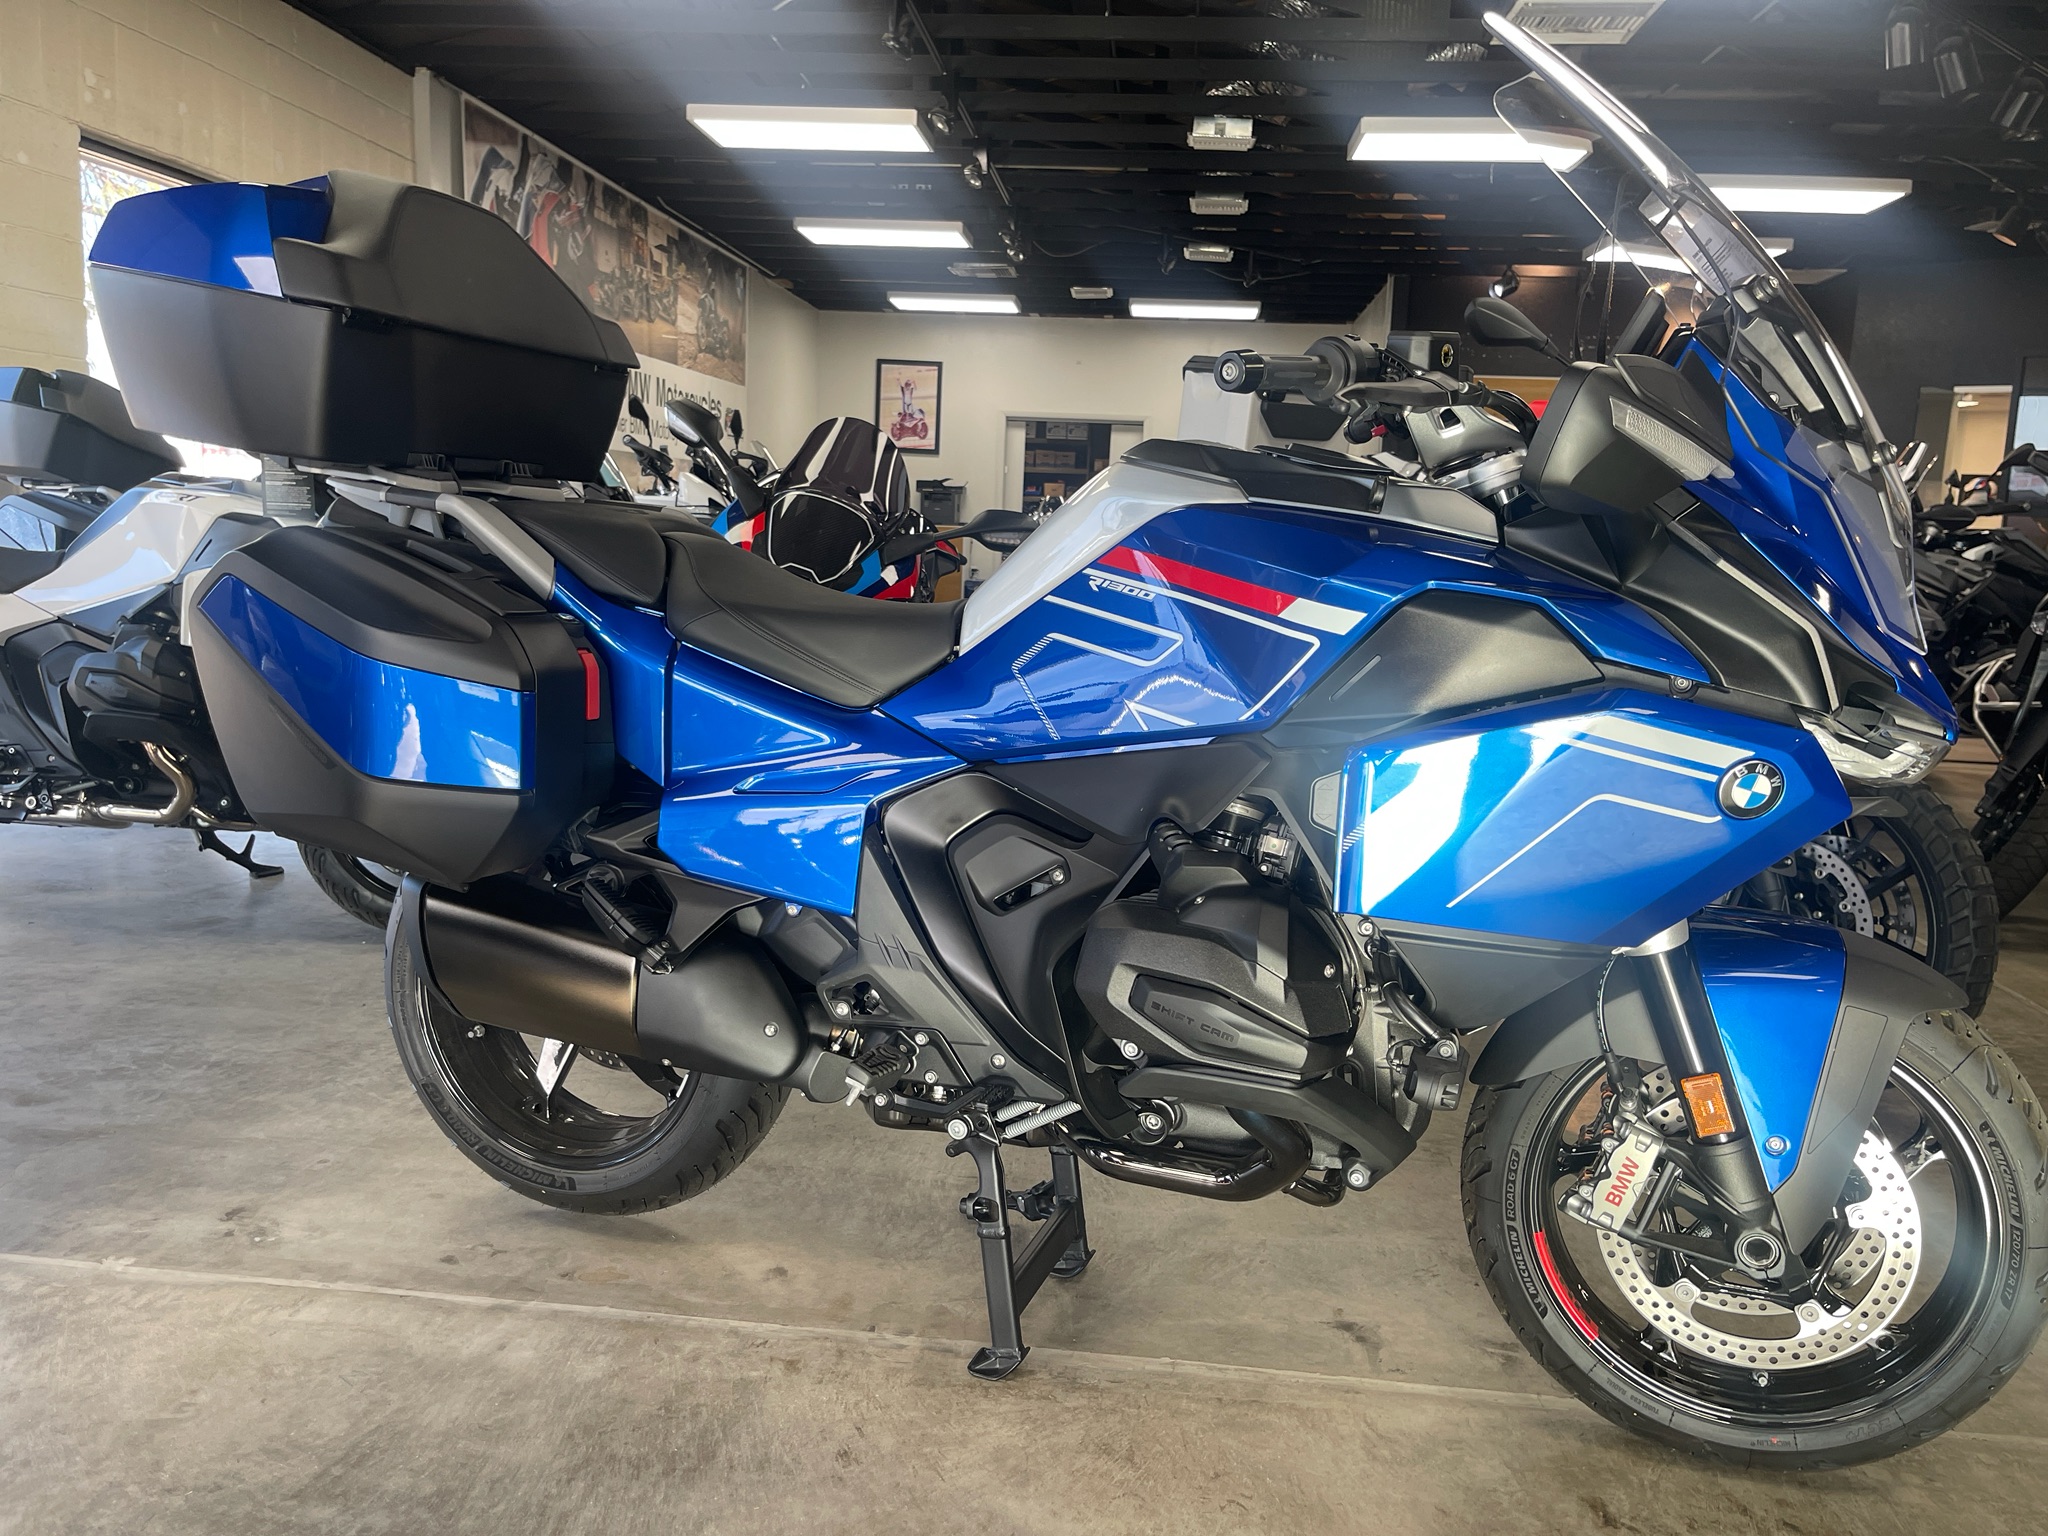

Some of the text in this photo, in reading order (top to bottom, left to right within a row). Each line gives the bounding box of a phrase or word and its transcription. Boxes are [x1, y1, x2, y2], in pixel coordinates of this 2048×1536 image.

[628, 370, 651, 404] MW
[1151, 1001, 1235, 1043] SHIFT CAM
[484, 1147, 552, 1185] MICHELIN
[1604, 1156, 1640, 1207] BMW
[1506, 1152, 1539, 1295] MICHELIN ROAD 6 GT
[1991, 1145, 2021, 1300] MICHELIN 120/70 ZR 17
